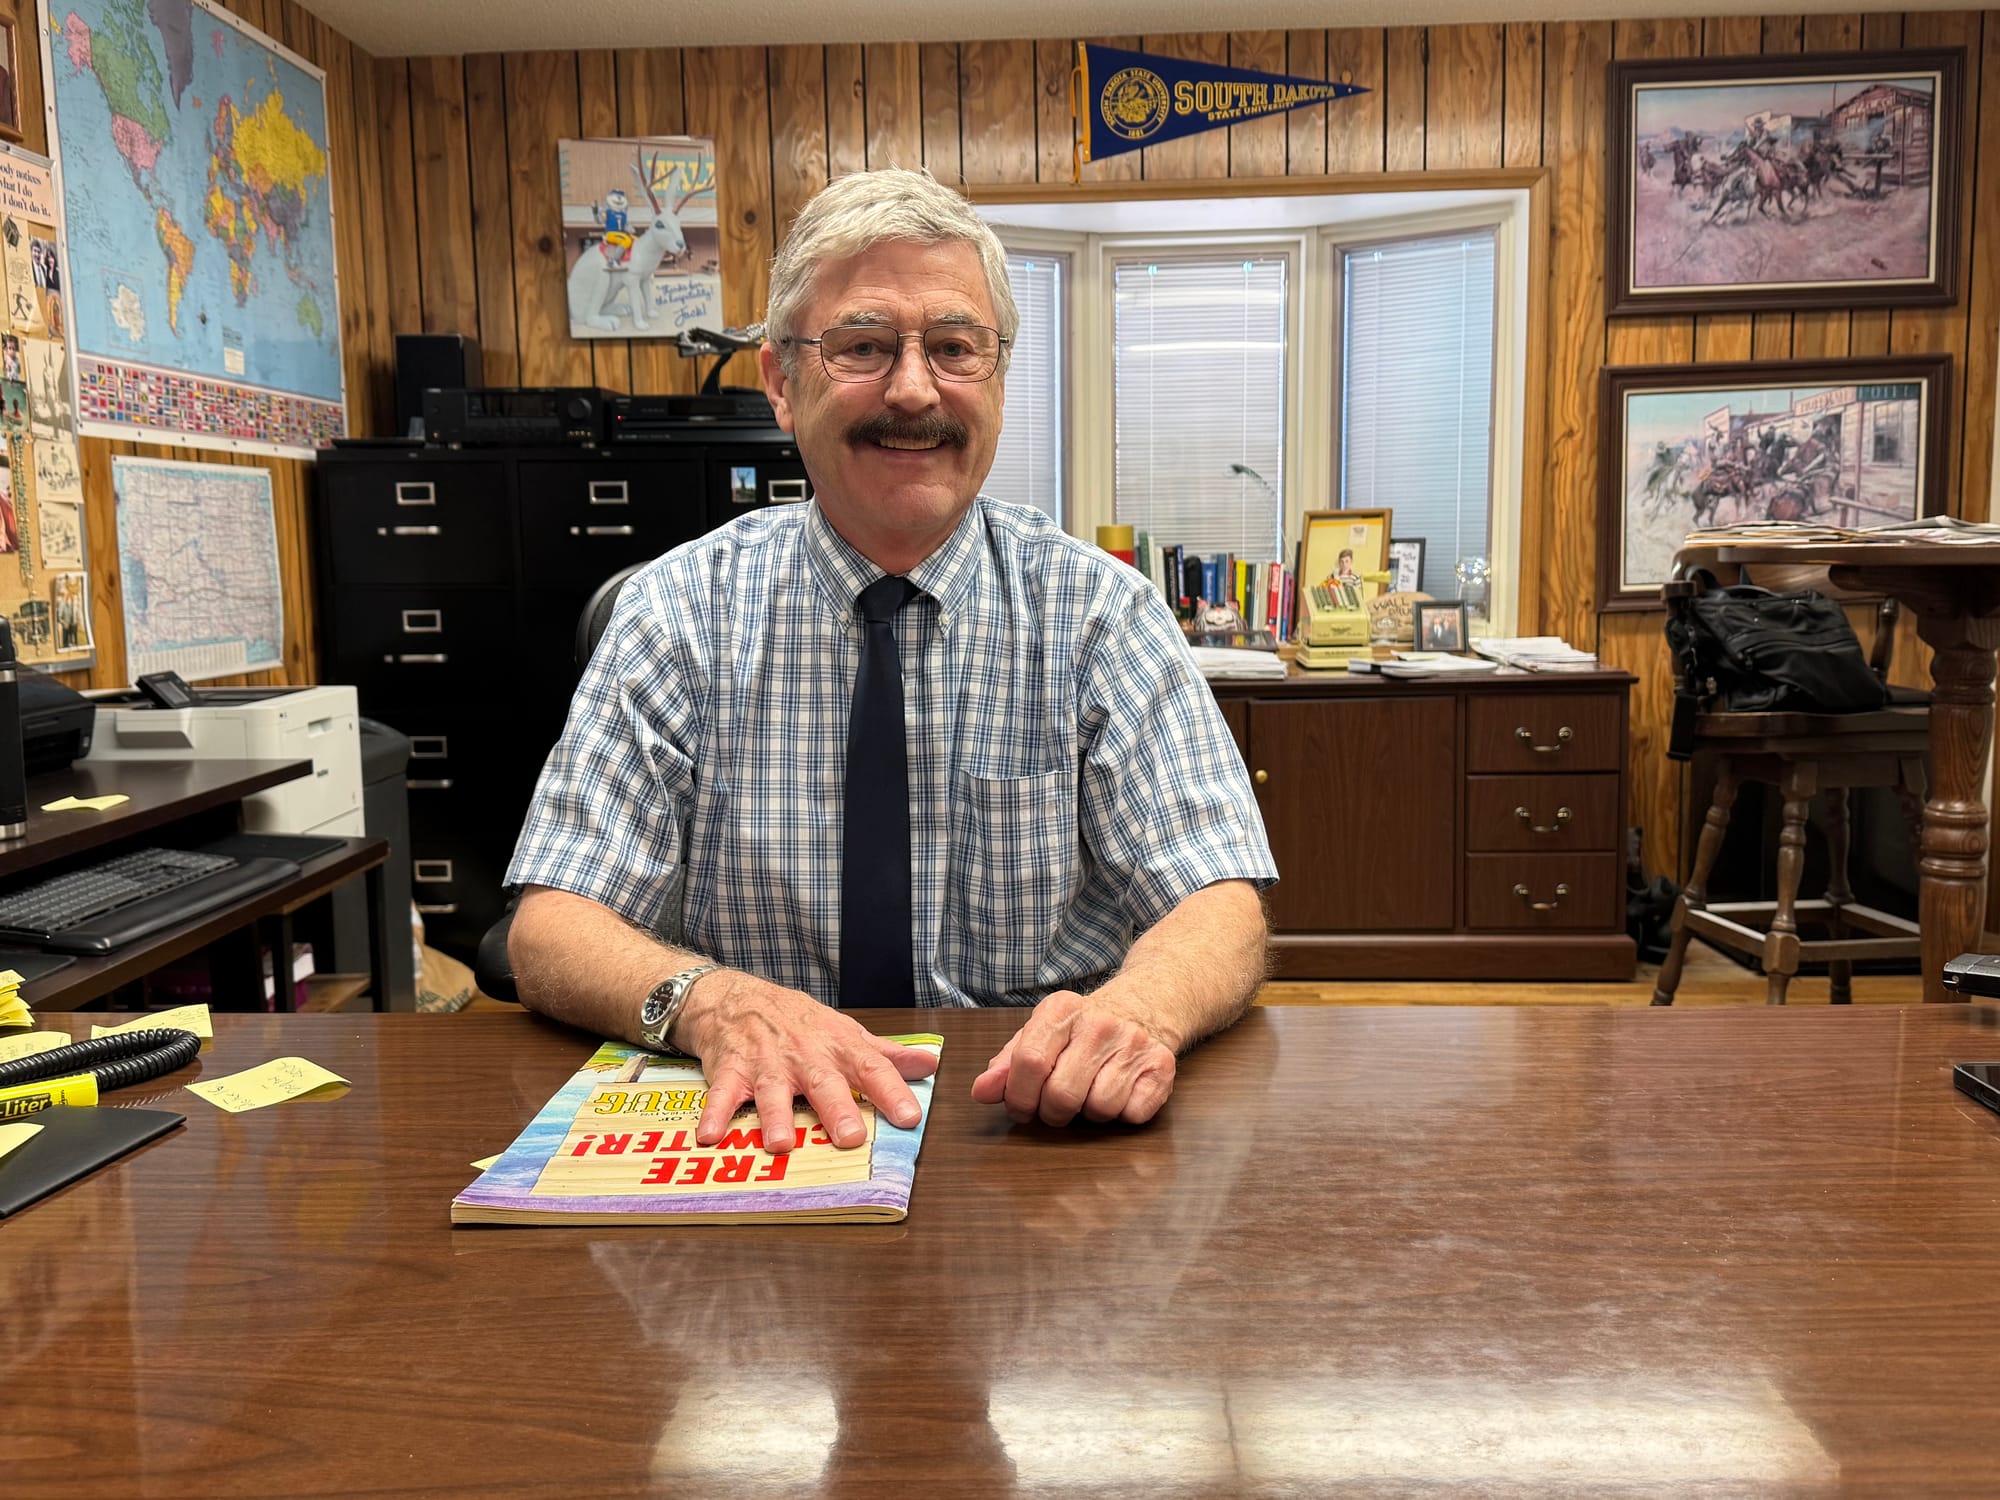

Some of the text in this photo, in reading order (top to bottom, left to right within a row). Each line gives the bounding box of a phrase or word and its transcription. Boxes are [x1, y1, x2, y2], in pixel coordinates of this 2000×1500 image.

[1174, 80, 1336, 115] SOUTH DAKOTA
[1207, 102, 1295, 121] STATE UNIVERSITY
[16, 170, 41, 185] notices
[17, 182, 21, 194] I
[22, 184, 32, 197] do
[8, 194, 27, 211] don't
[29, 201, 40, 214] do
[41, 203, 51, 217] it.
[1373, 596, 1410, 611] WALL
[571, 1128, 765, 1157] WTER!
[641, 1154, 790, 1185] FREE
